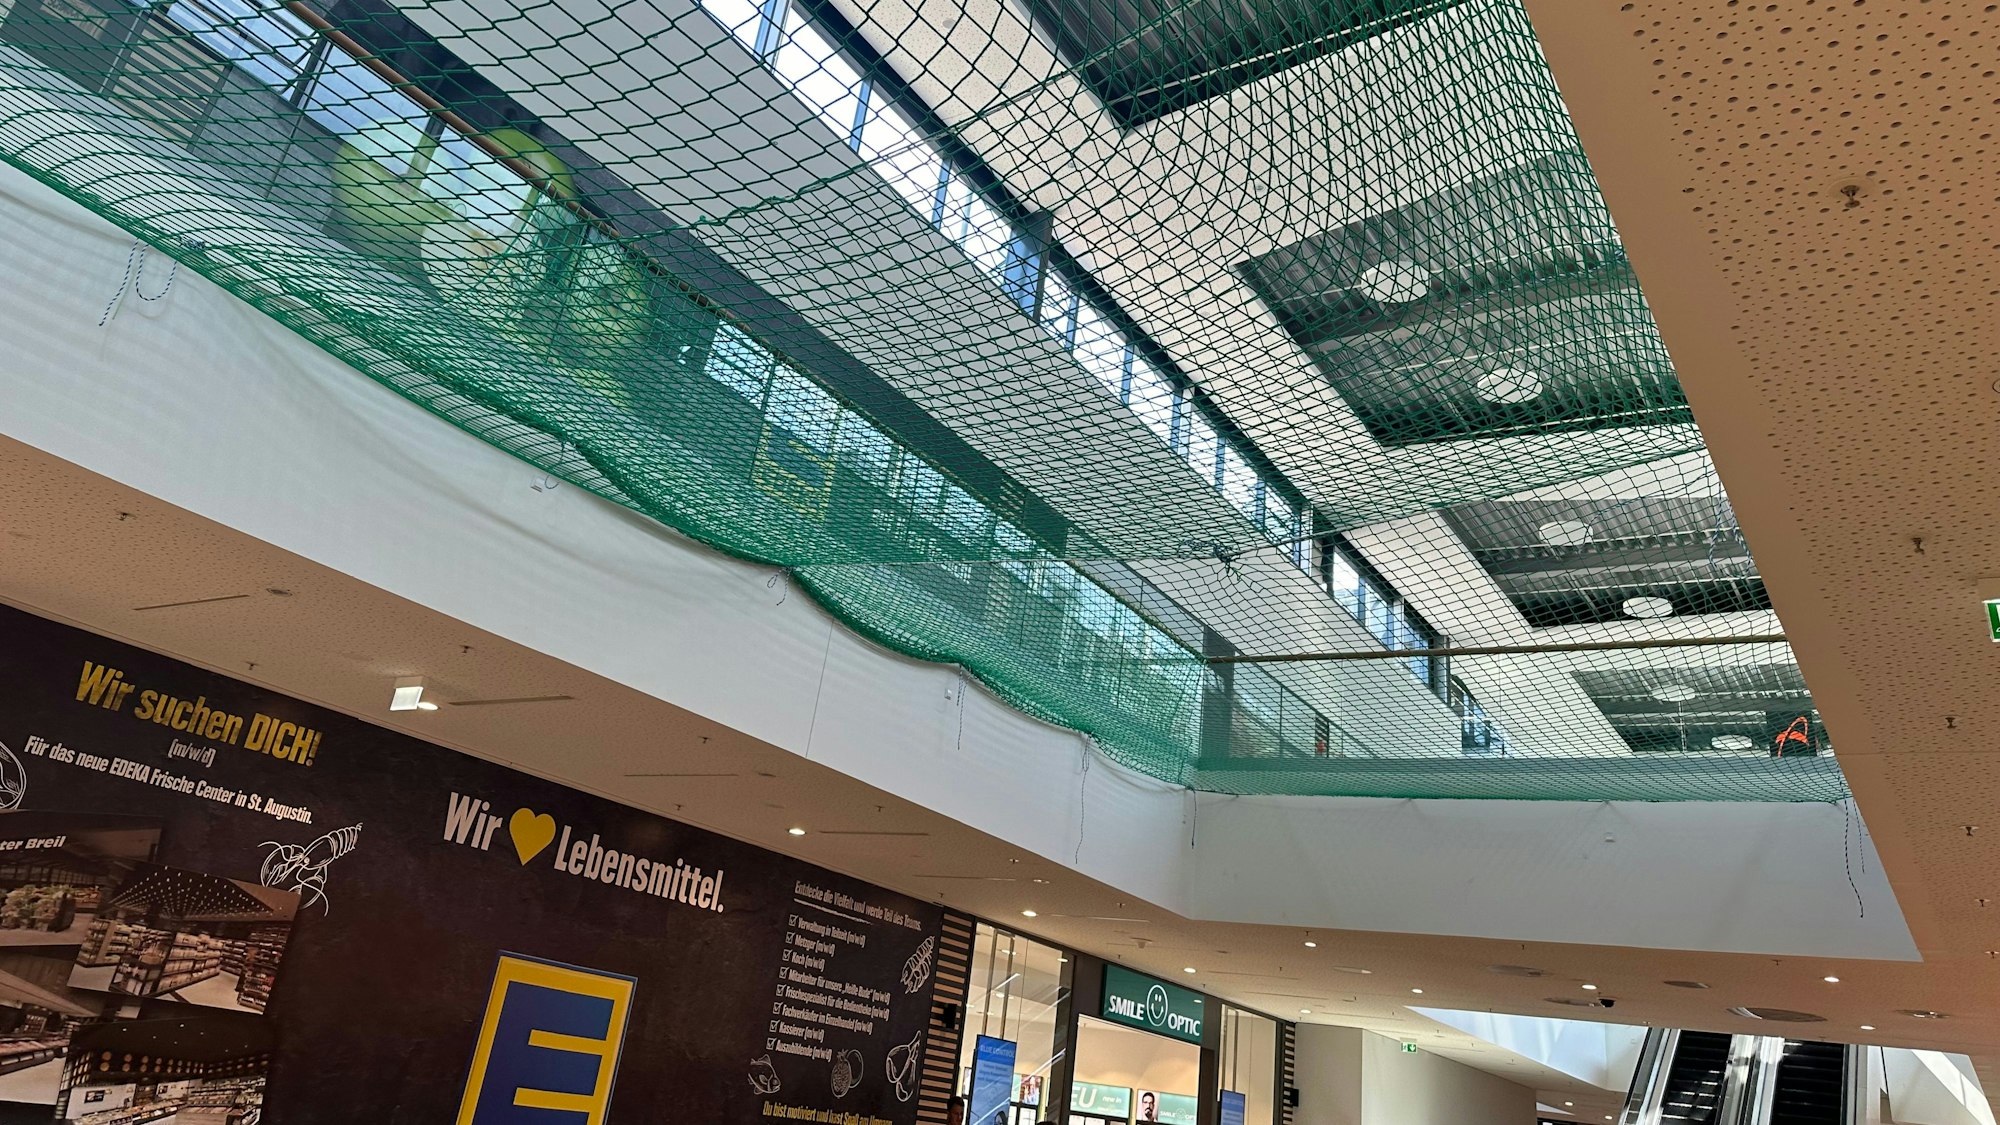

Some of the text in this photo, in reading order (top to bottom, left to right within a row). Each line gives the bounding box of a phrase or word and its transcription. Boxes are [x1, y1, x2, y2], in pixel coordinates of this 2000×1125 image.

[75, 660, 323, 767] Wir suchen DICH!
[24, 735, 314, 825] Für das neue EDEKA Frische Center in St. Augustin.
[25, 835, 67, 849] Breil
[443, 791, 726, 914] Wir Lebensmittel.
[794, 880, 824, 900] Entdecke
[824, 888, 832, 904] die
[834, 892, 854, 910] Vielfalt
[854, 900, 866, 914] und
[866, 904, 884, 920] werde
[884, 908, 894, 922] Teil
[892, 912, 904, 926] des
[798, 918, 826, 938] Verwaltung
[832, 926, 848, 940] Teilzeit
[794, 934, 816, 950] Metzger
[792, 952, 806, 966] Koch
[788, 968, 818, 986] Mitarbeiter
[816, 976, 824, 988] für
[824, 980, 842, 990] unsere
[786, 986, 826, 1006] Frischespezialist
[826, 996, 836, 1008] für
[782, 1004, 818, 1022] Fachverkäufer
[826, 1014, 854, 1030] Einzelhandel
[1108, 993, 1201, 1037] SMILE OPTIC
[778, 1022, 806, 1036] Kassierer
[776, 1040, 812, 1056] Auszubildende
[762, 1100, 772, 1116] Du
[772, 1102, 786, 1118] bist
[786, 1106, 816, 1122] motiviert
[816, 1110, 828, 1124] und
[830, 1110, 844, 1125] hast
